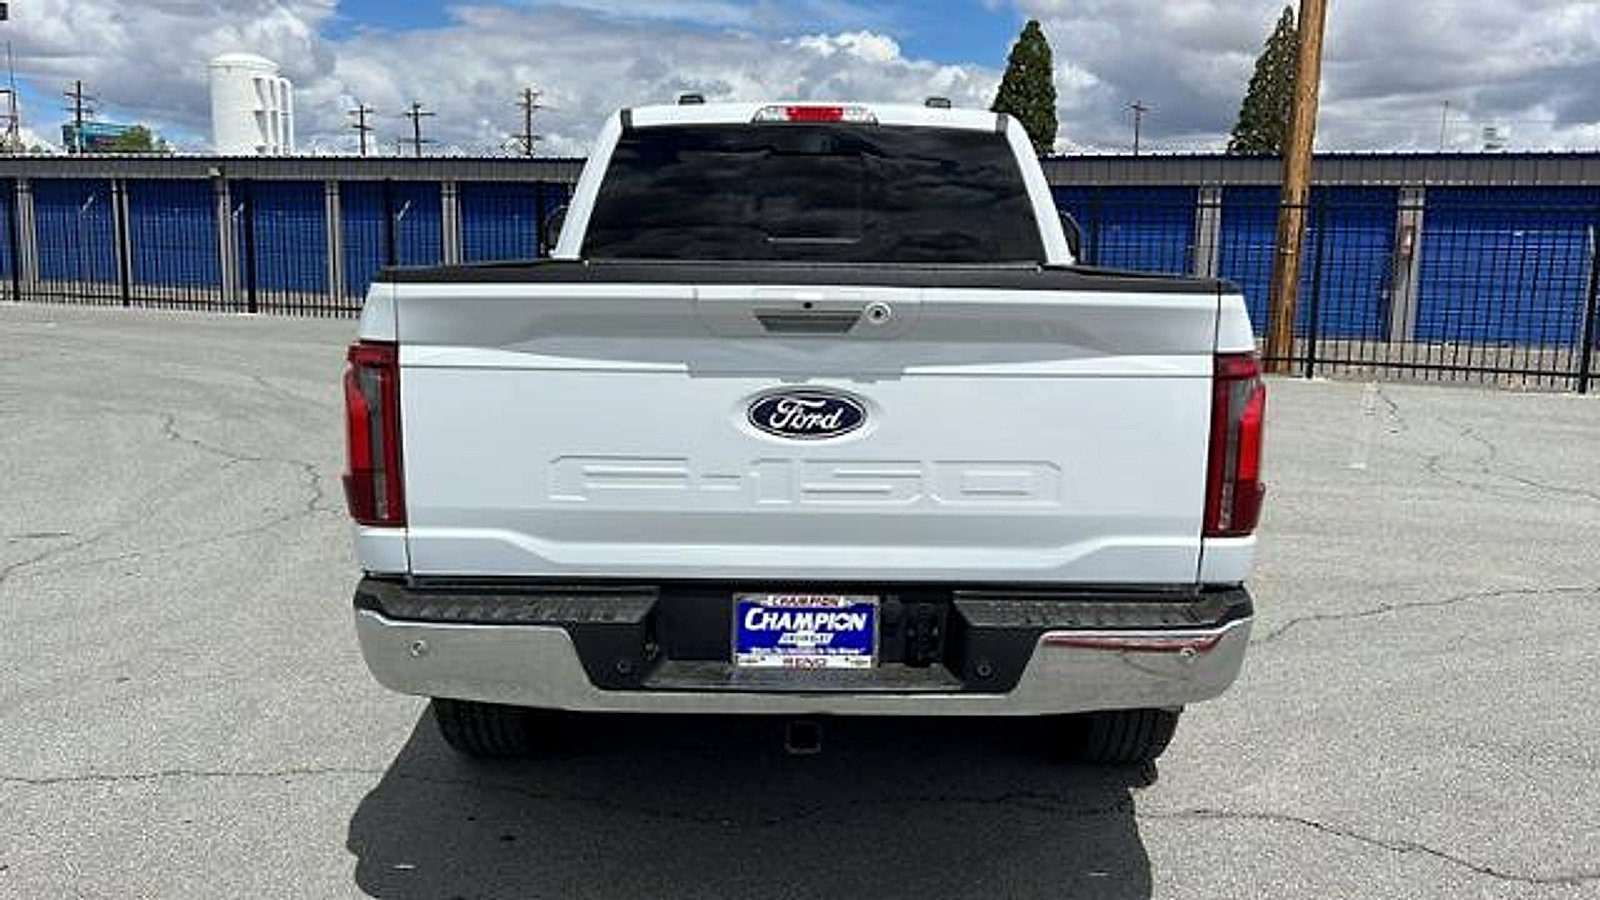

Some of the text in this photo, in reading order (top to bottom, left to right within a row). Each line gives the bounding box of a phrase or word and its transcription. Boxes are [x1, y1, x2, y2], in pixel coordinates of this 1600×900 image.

[769, 397, 841, 431] Ford
[549, 455, 1062, 507] F-150
[744, 607, 868, 632] CHAMPION
